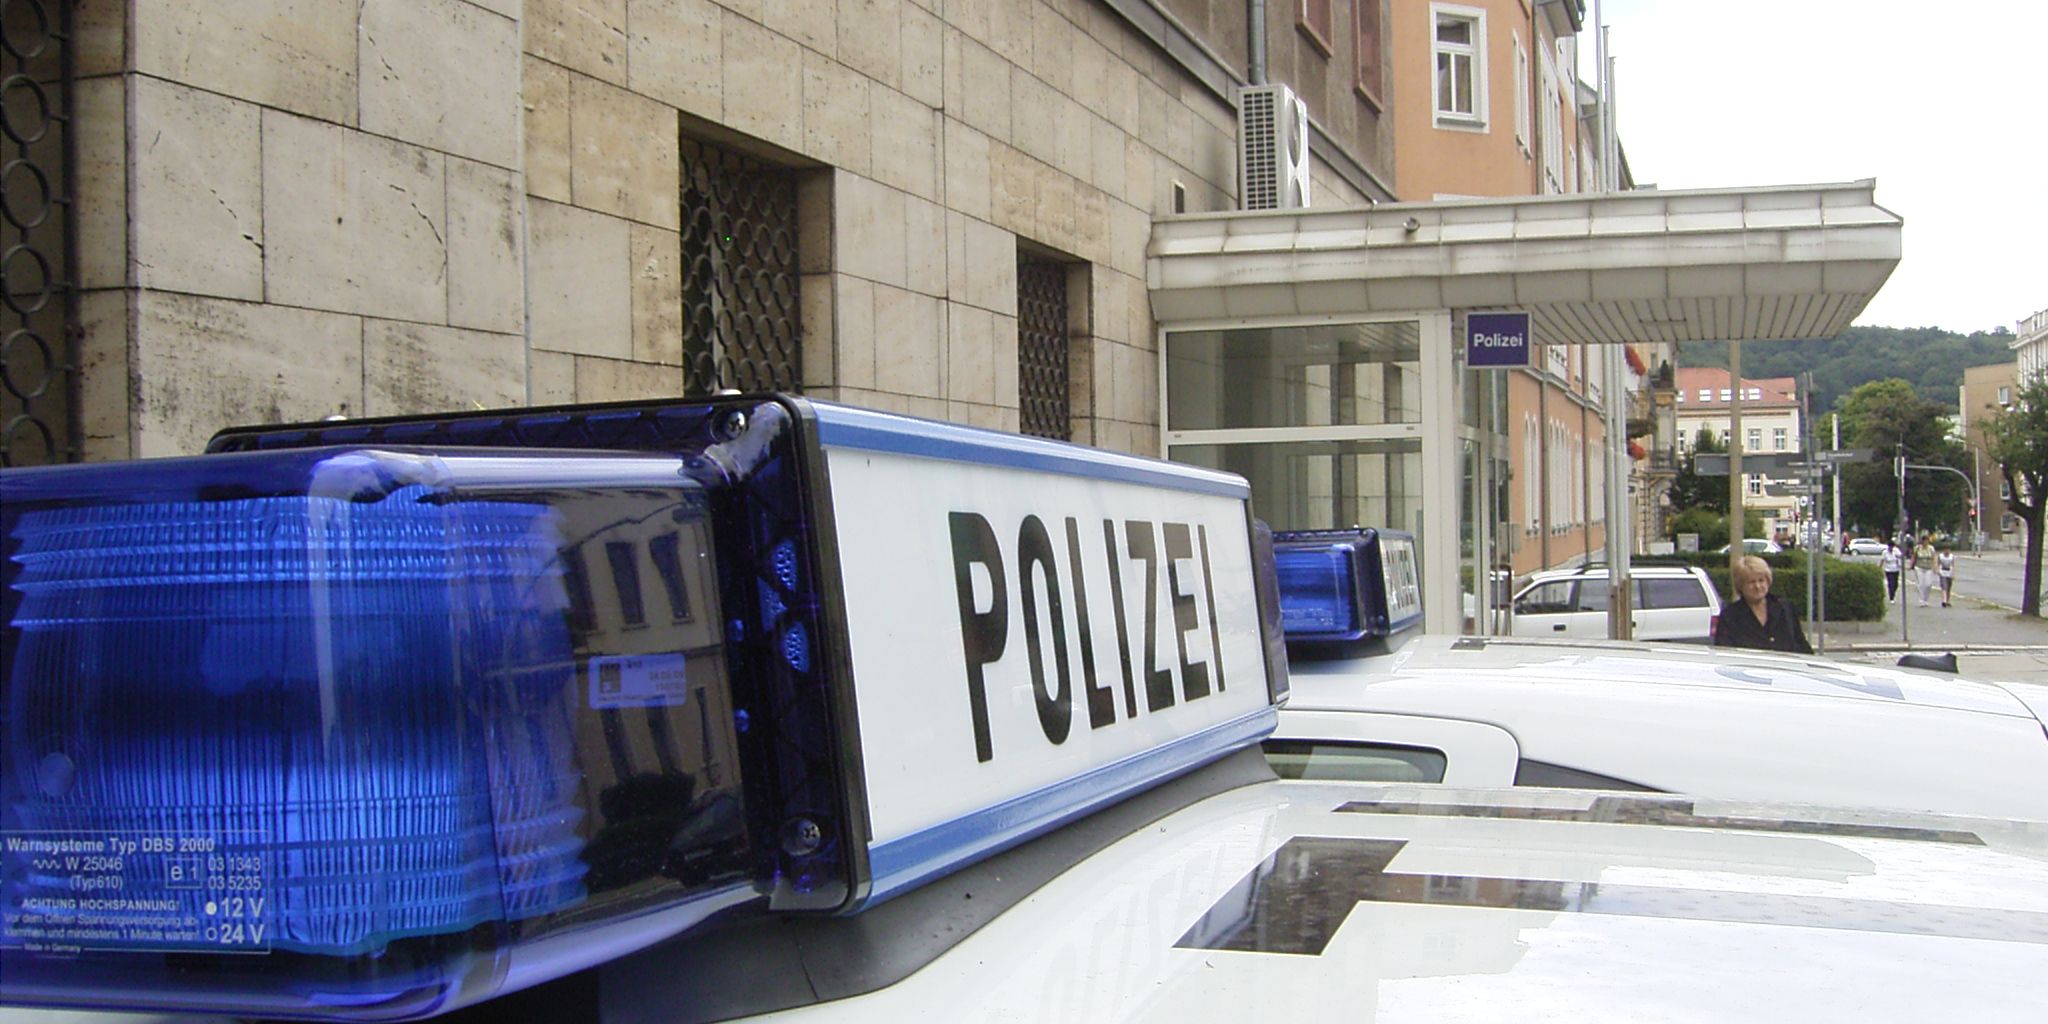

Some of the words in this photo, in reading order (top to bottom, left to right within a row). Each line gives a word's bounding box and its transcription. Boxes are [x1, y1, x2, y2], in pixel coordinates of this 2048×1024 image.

[1473, 332, 1523, 347] Polizei
[948, 511, 1226, 763] POLIZEI
[7, 837, 105, 855] Warnsysteme
[110, 837, 137, 855] Typ
[142, 838, 175, 852] DBS
[180, 838, 215, 852] 2000
[65, 857, 80, 871] W
[83, 857, 123, 871] 25046
[208, 856, 225, 871] 03
[229, 856, 261, 871] 1343
[171, 865, 183, 881] e
[190, 866, 197, 880] 1
[208, 875, 225, 890] 03
[228, 875, 262, 890] 5235
[22, 898, 77, 909] ACHTUNG
[80, 898, 180, 911] HOCHSPANNUNG!
[221, 897, 244, 917] 12
[249, 897, 265, 917] V
[220, 923, 245, 944] 24
[249, 923, 265, 945] V
